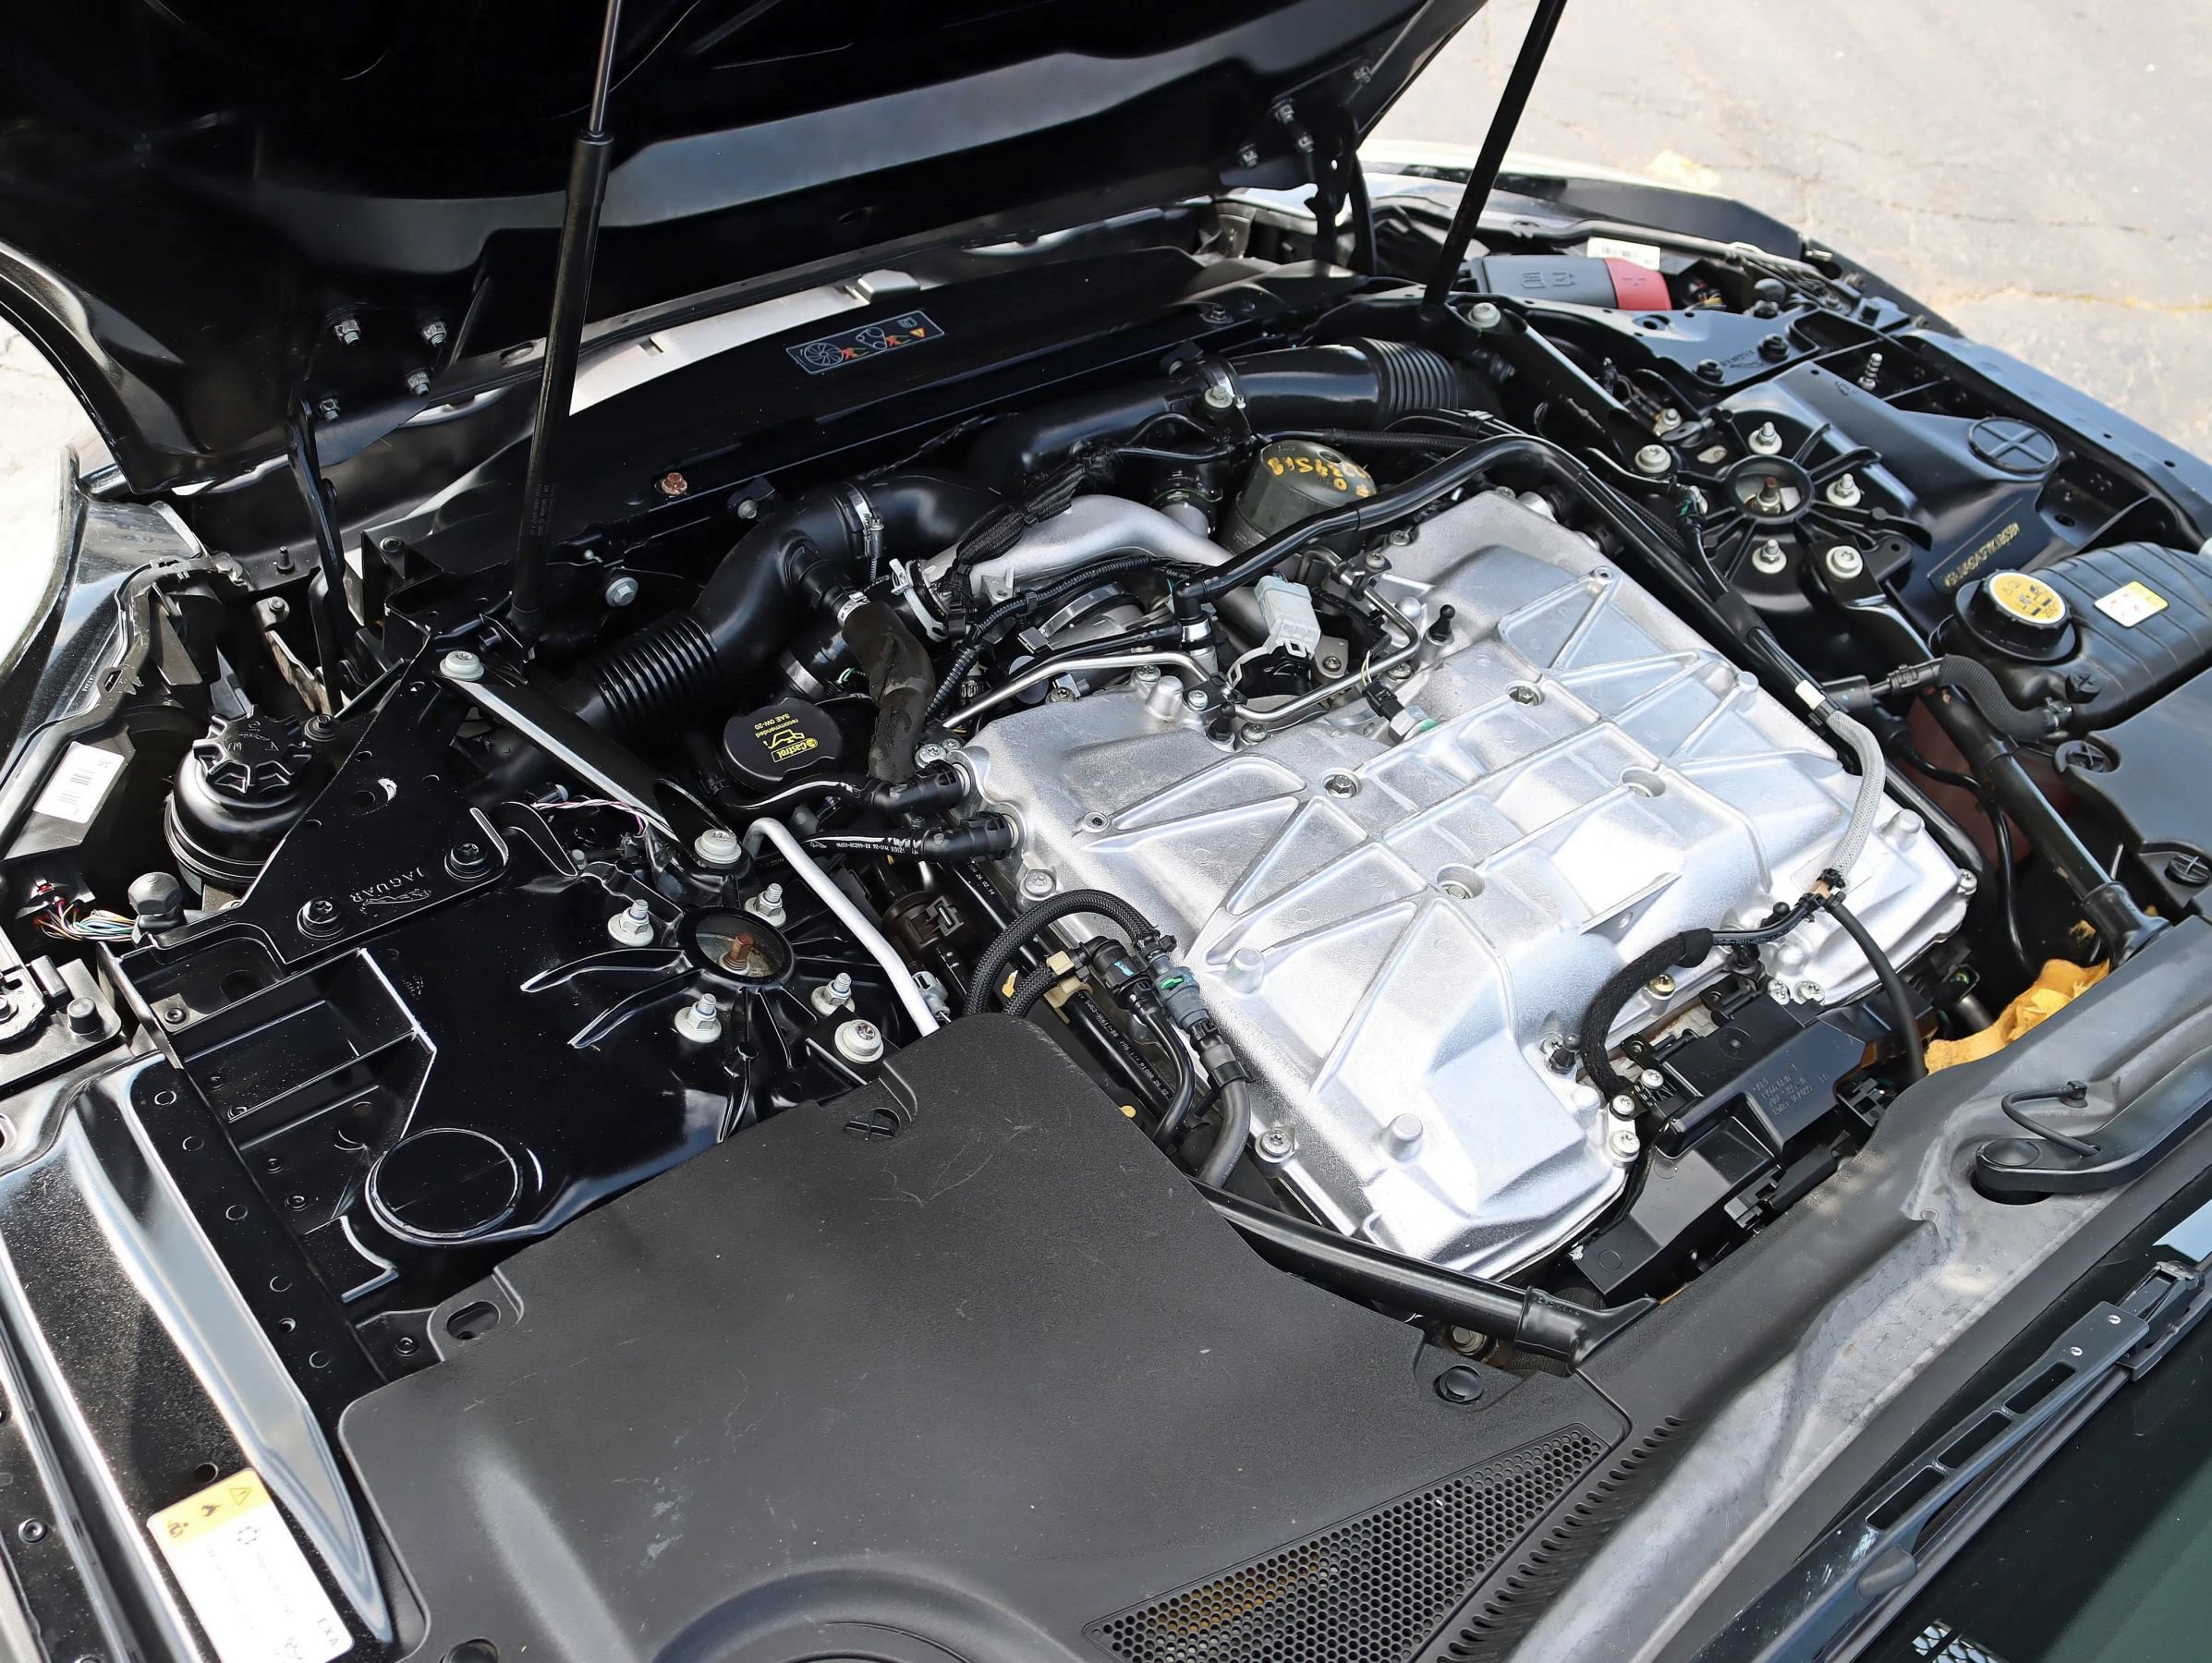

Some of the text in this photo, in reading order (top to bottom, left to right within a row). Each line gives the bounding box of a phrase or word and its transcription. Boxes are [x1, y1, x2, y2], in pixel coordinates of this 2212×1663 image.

[754, 713, 790, 730] SAE 0W-20
[755, 718, 799, 739] recommended
[777, 742, 808, 759] Castrol
[350, 867, 425, 903] JAGUAR
